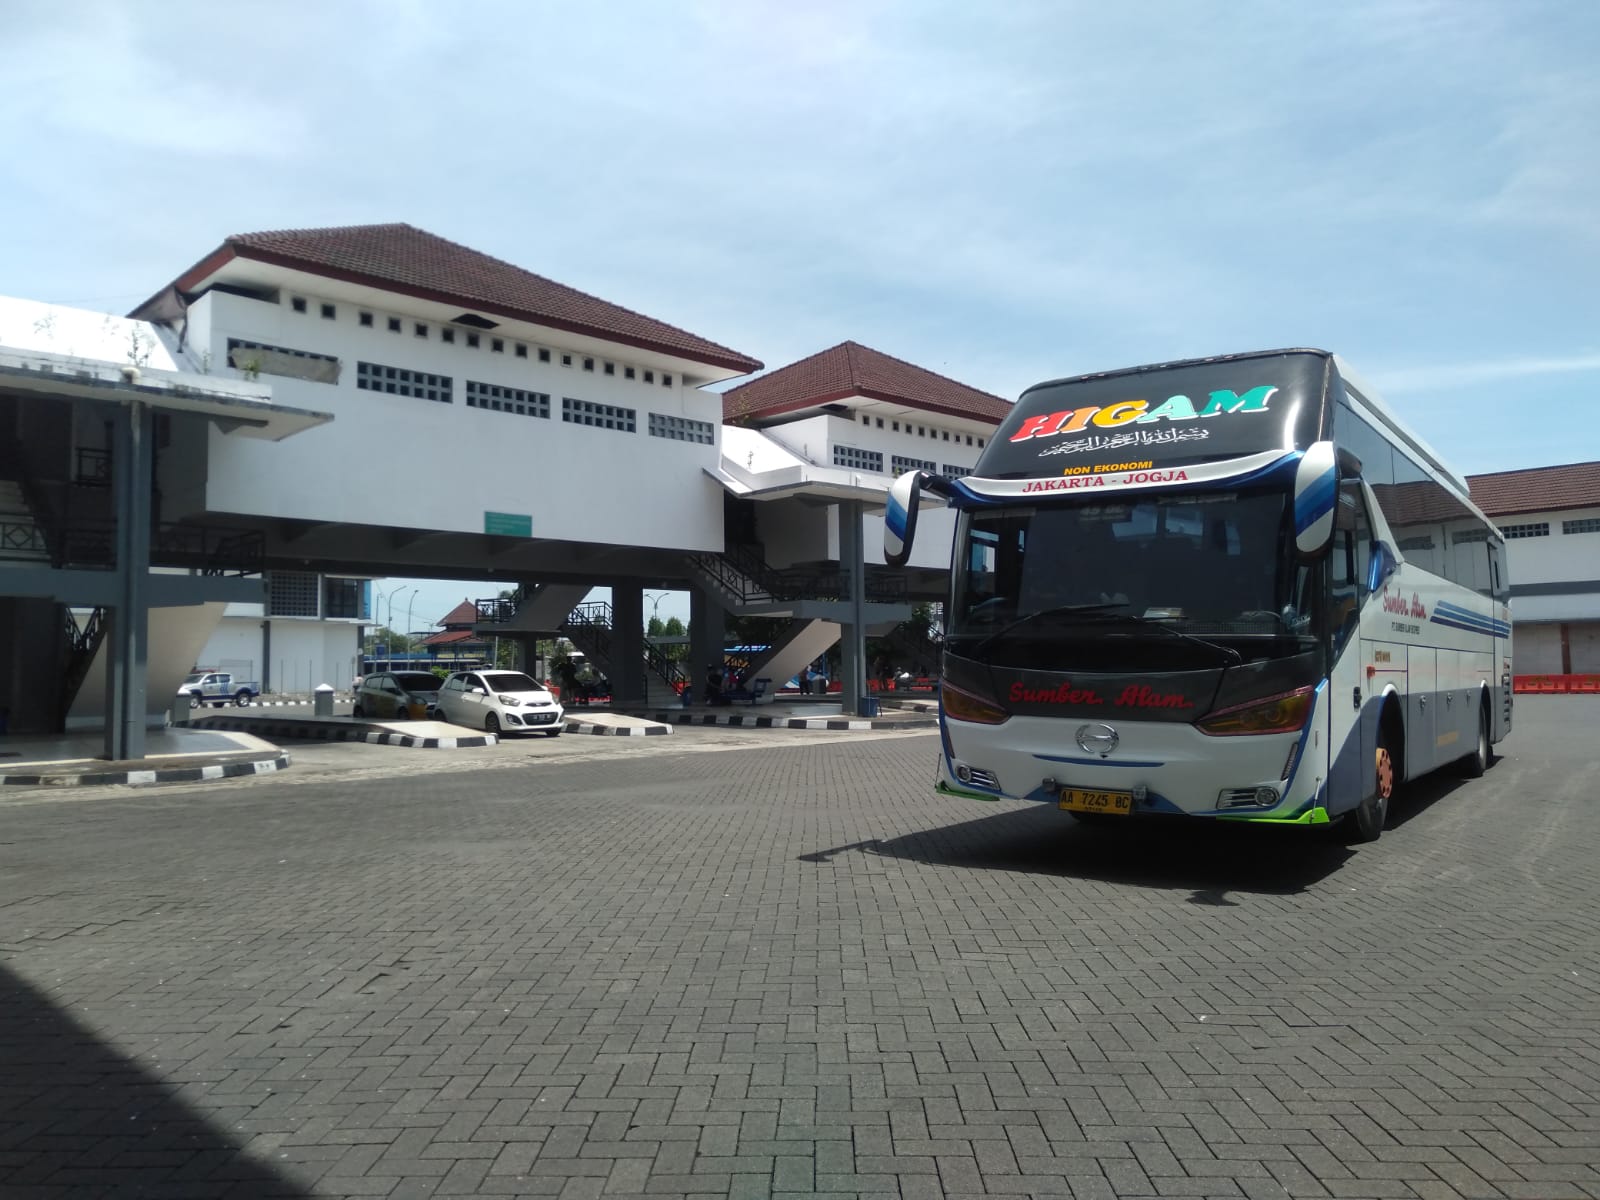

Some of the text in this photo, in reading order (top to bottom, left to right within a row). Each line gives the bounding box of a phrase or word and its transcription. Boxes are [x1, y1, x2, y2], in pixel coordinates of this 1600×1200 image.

[1010, 386, 1279, 442] HIGAM
[1064, 461, 1153, 475] NON EKONOMI
[1022, 476, 1105, 492] JAKARTA
[1123, 471, 1188, 484] JOGJA
[1061, 791, 1073, 804] AA
[1082, 793, 1109, 807] 7245
